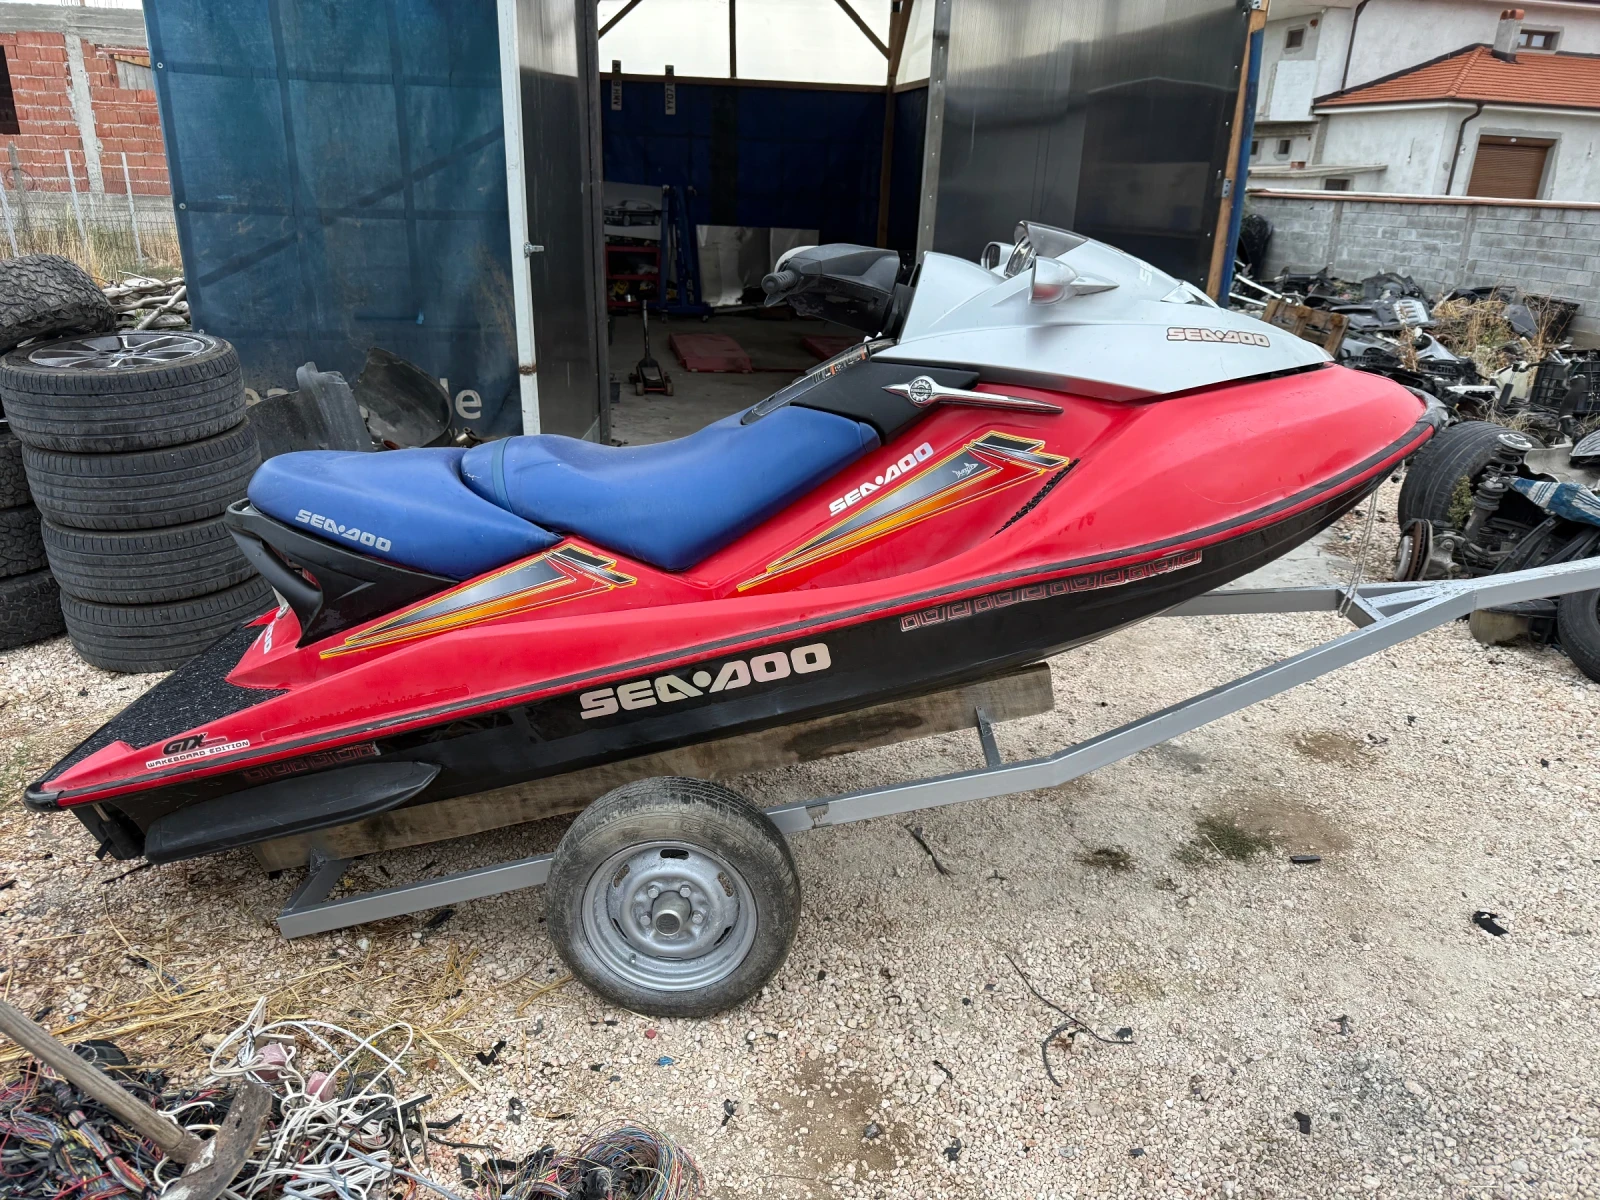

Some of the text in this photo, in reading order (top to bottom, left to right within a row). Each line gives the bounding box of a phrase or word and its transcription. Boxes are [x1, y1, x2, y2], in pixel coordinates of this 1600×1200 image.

[147, 750, 206, 768] WAKEBOARD
[209, 740, 249, 754] EDITION
[164, 732, 207, 755] GTX
